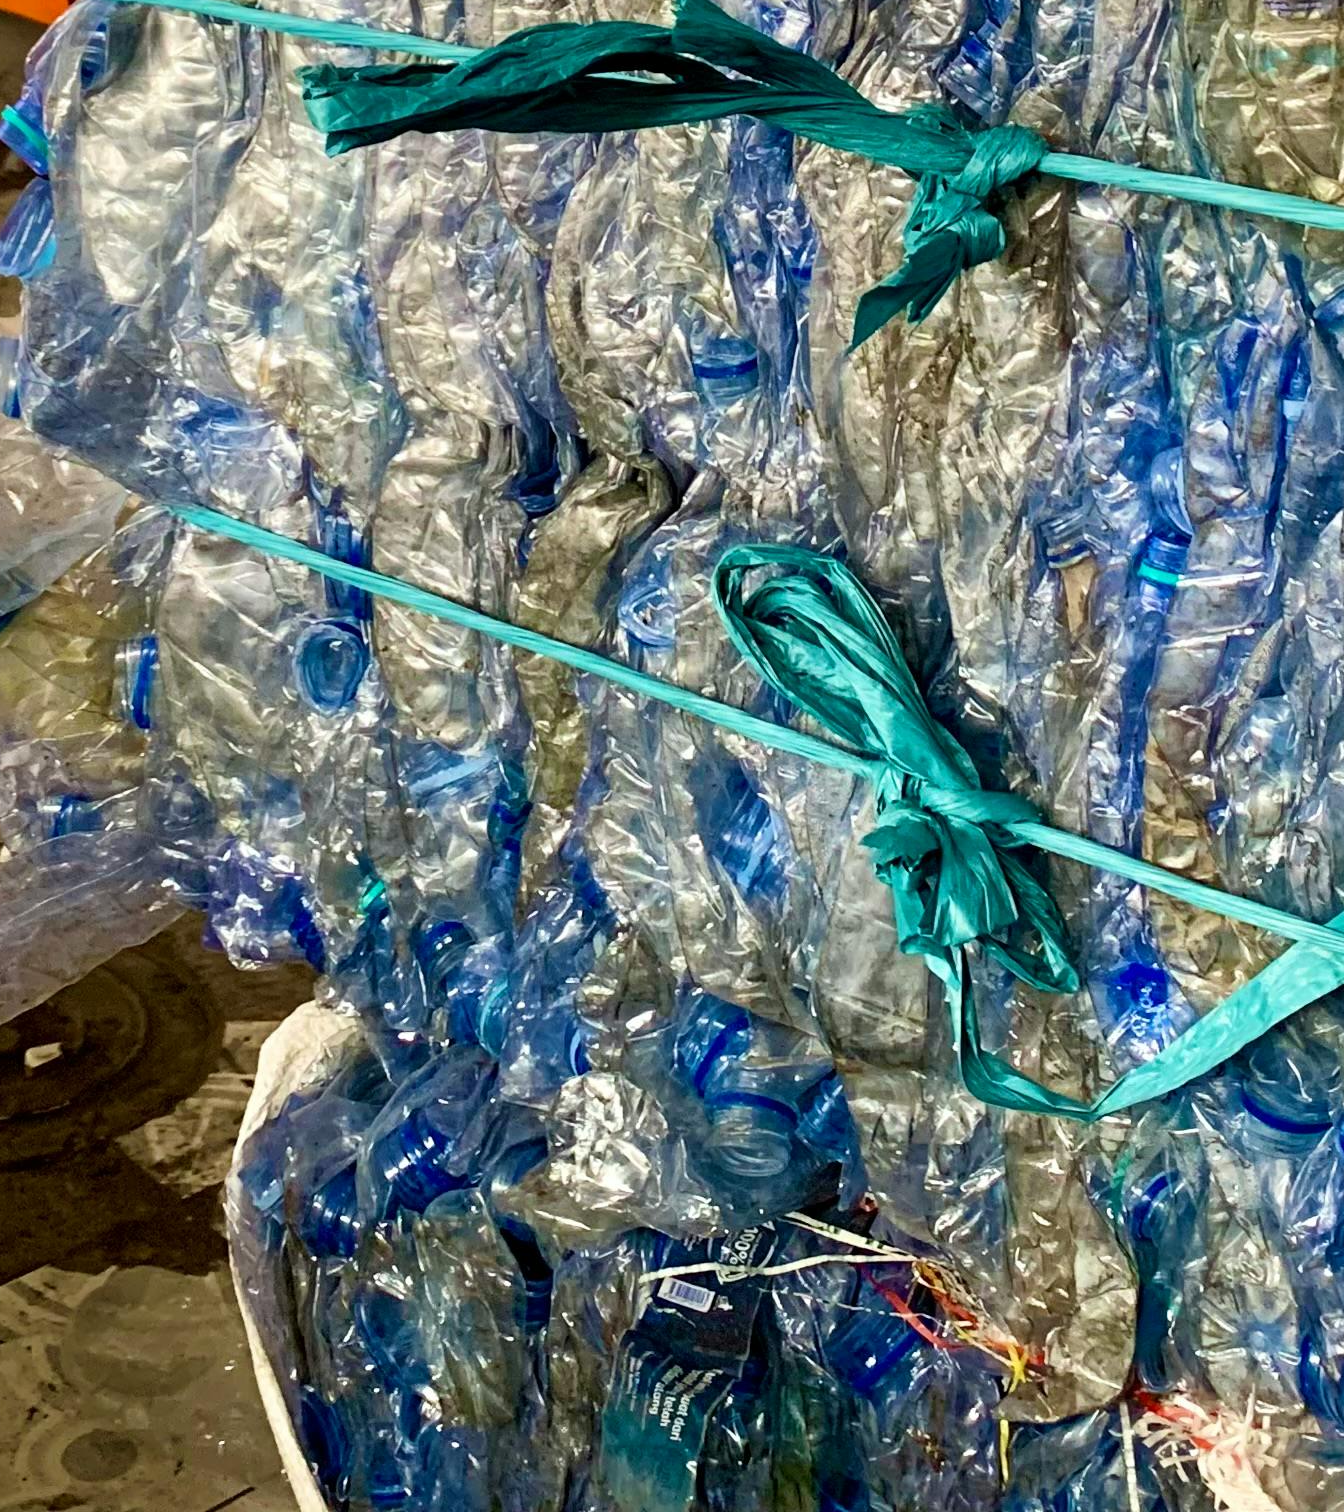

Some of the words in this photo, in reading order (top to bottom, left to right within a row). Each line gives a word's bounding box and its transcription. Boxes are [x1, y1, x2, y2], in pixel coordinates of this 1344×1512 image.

[729, 1227, 759, 1264] 100%
[659, 1396, 677, 1427] telah
[669, 1416, 687, 1442] dari
